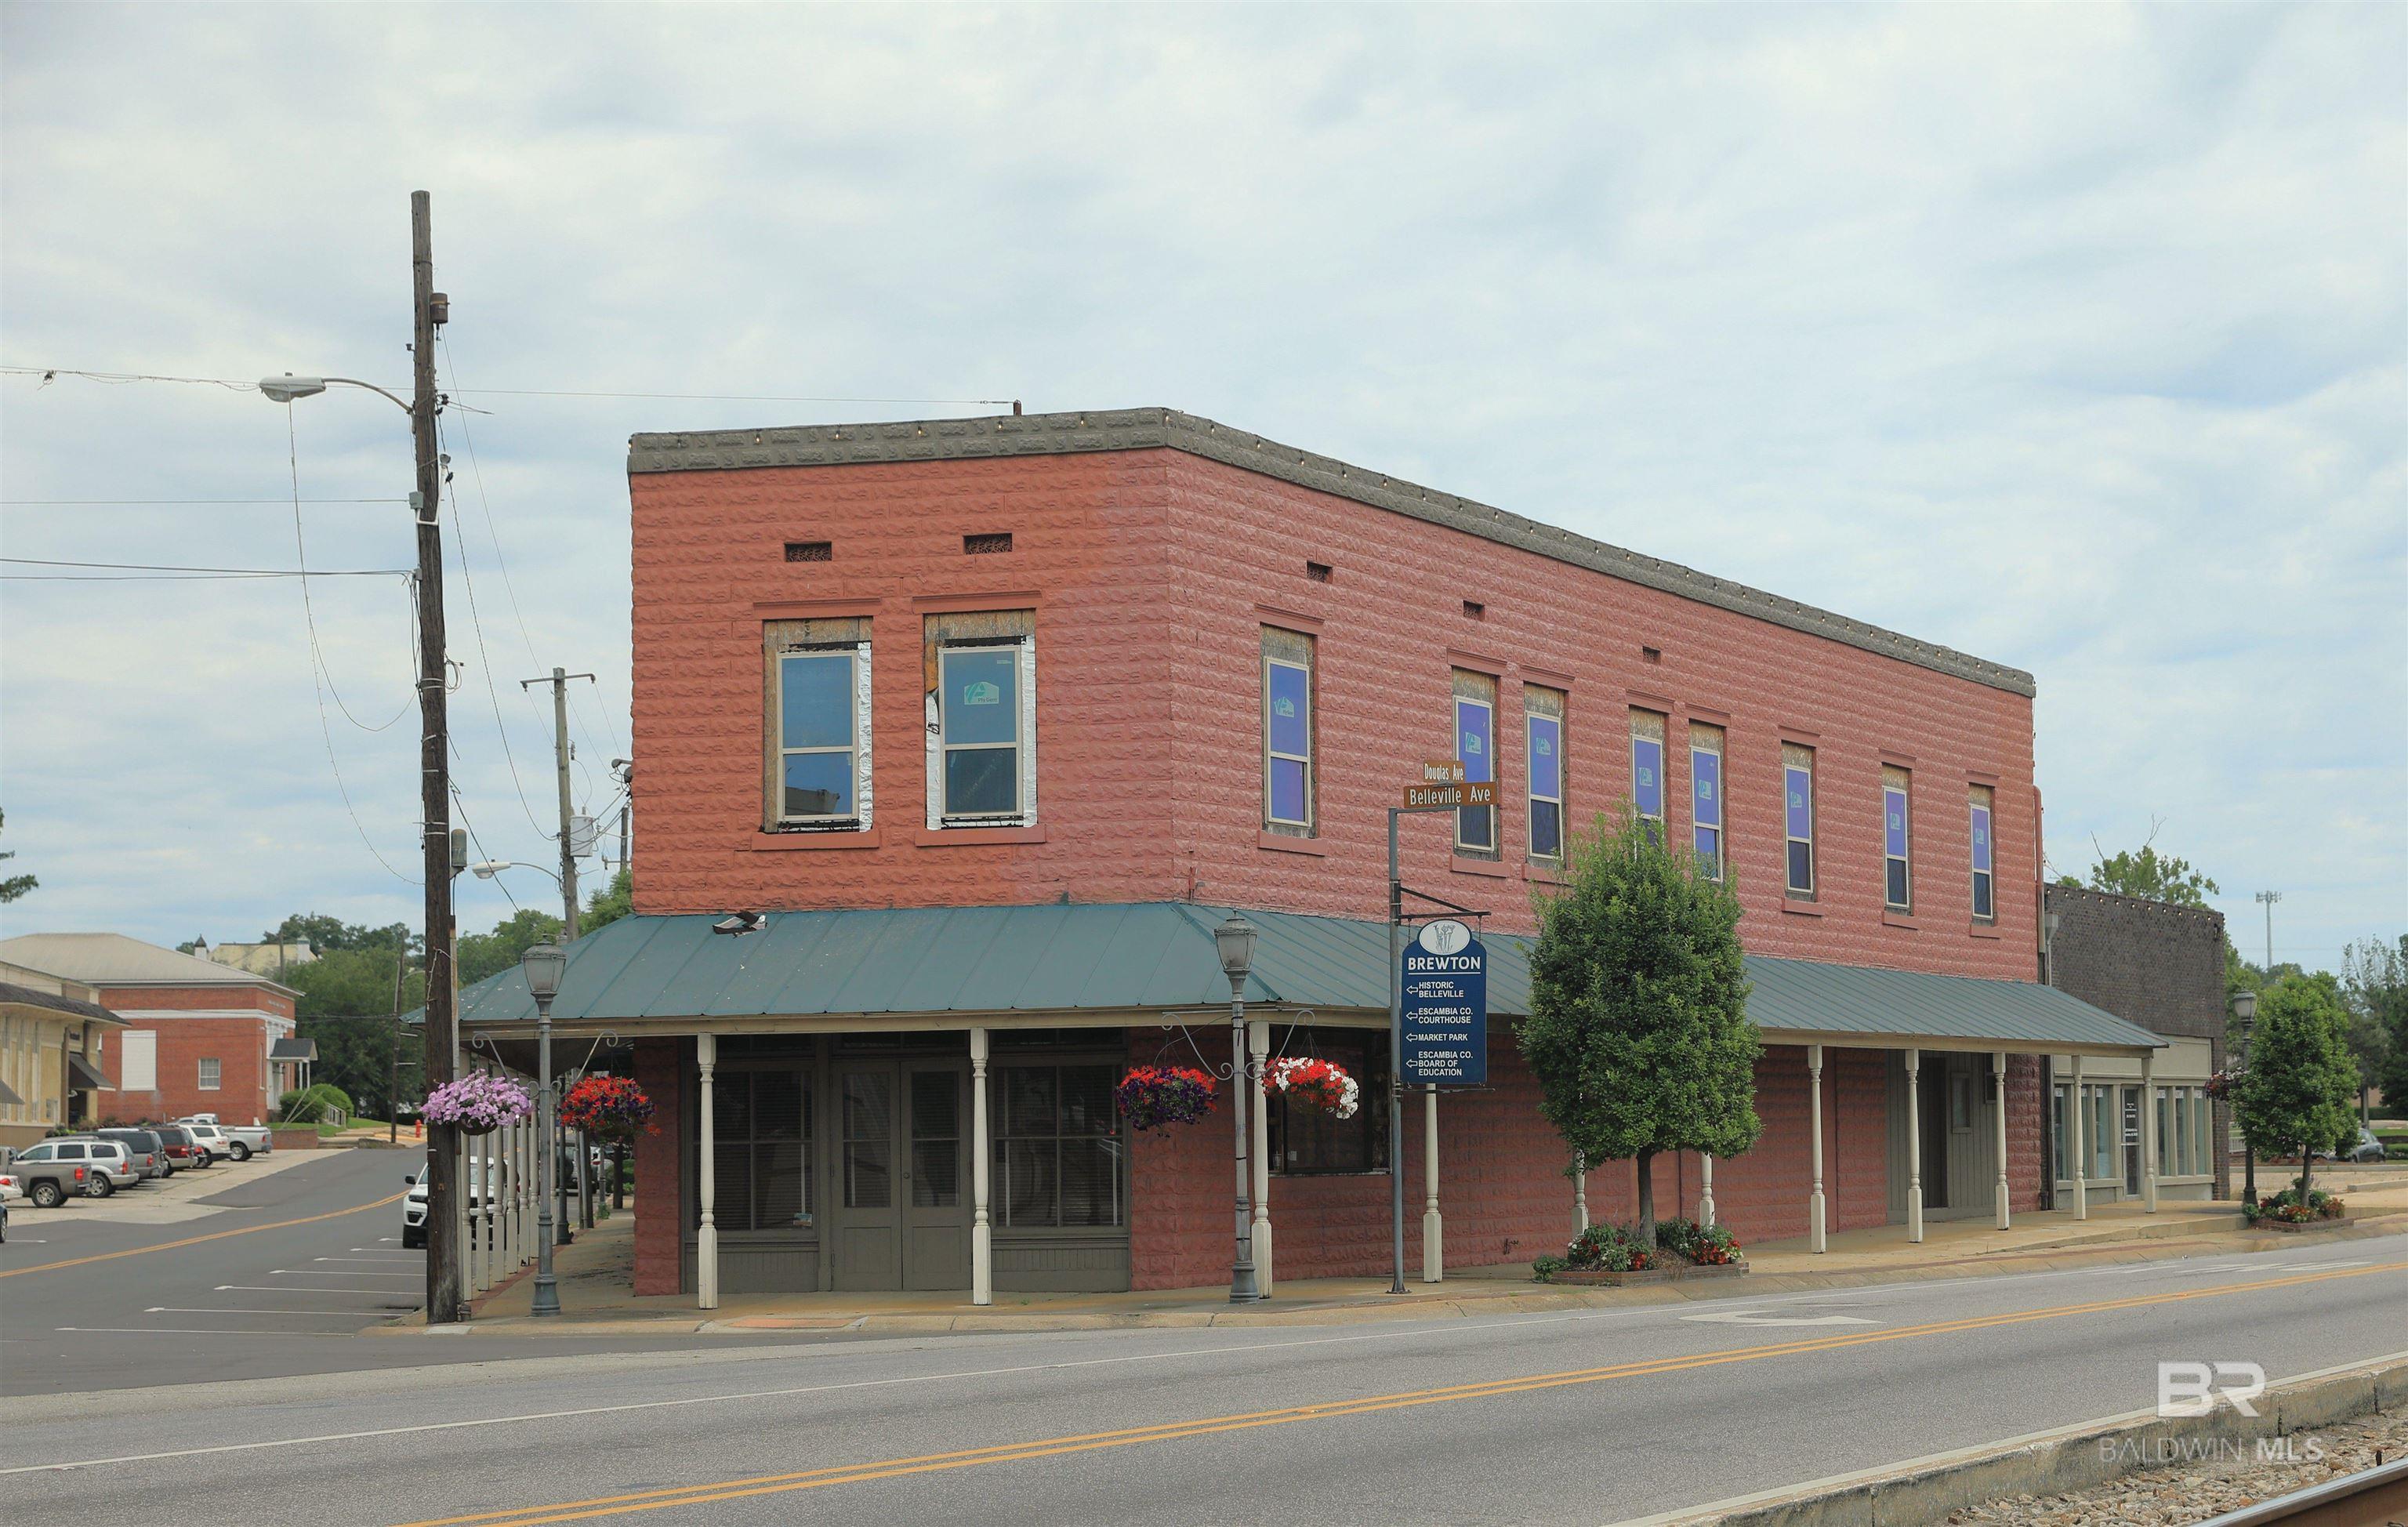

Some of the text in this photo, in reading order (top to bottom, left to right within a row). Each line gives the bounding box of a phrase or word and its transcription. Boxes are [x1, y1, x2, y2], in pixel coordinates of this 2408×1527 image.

[1424, 763, 1463, 782] Douglas Ave
[1409, 785, 1491, 805] Belleville Ave
[1408, 956, 1481, 970] BREWTON
